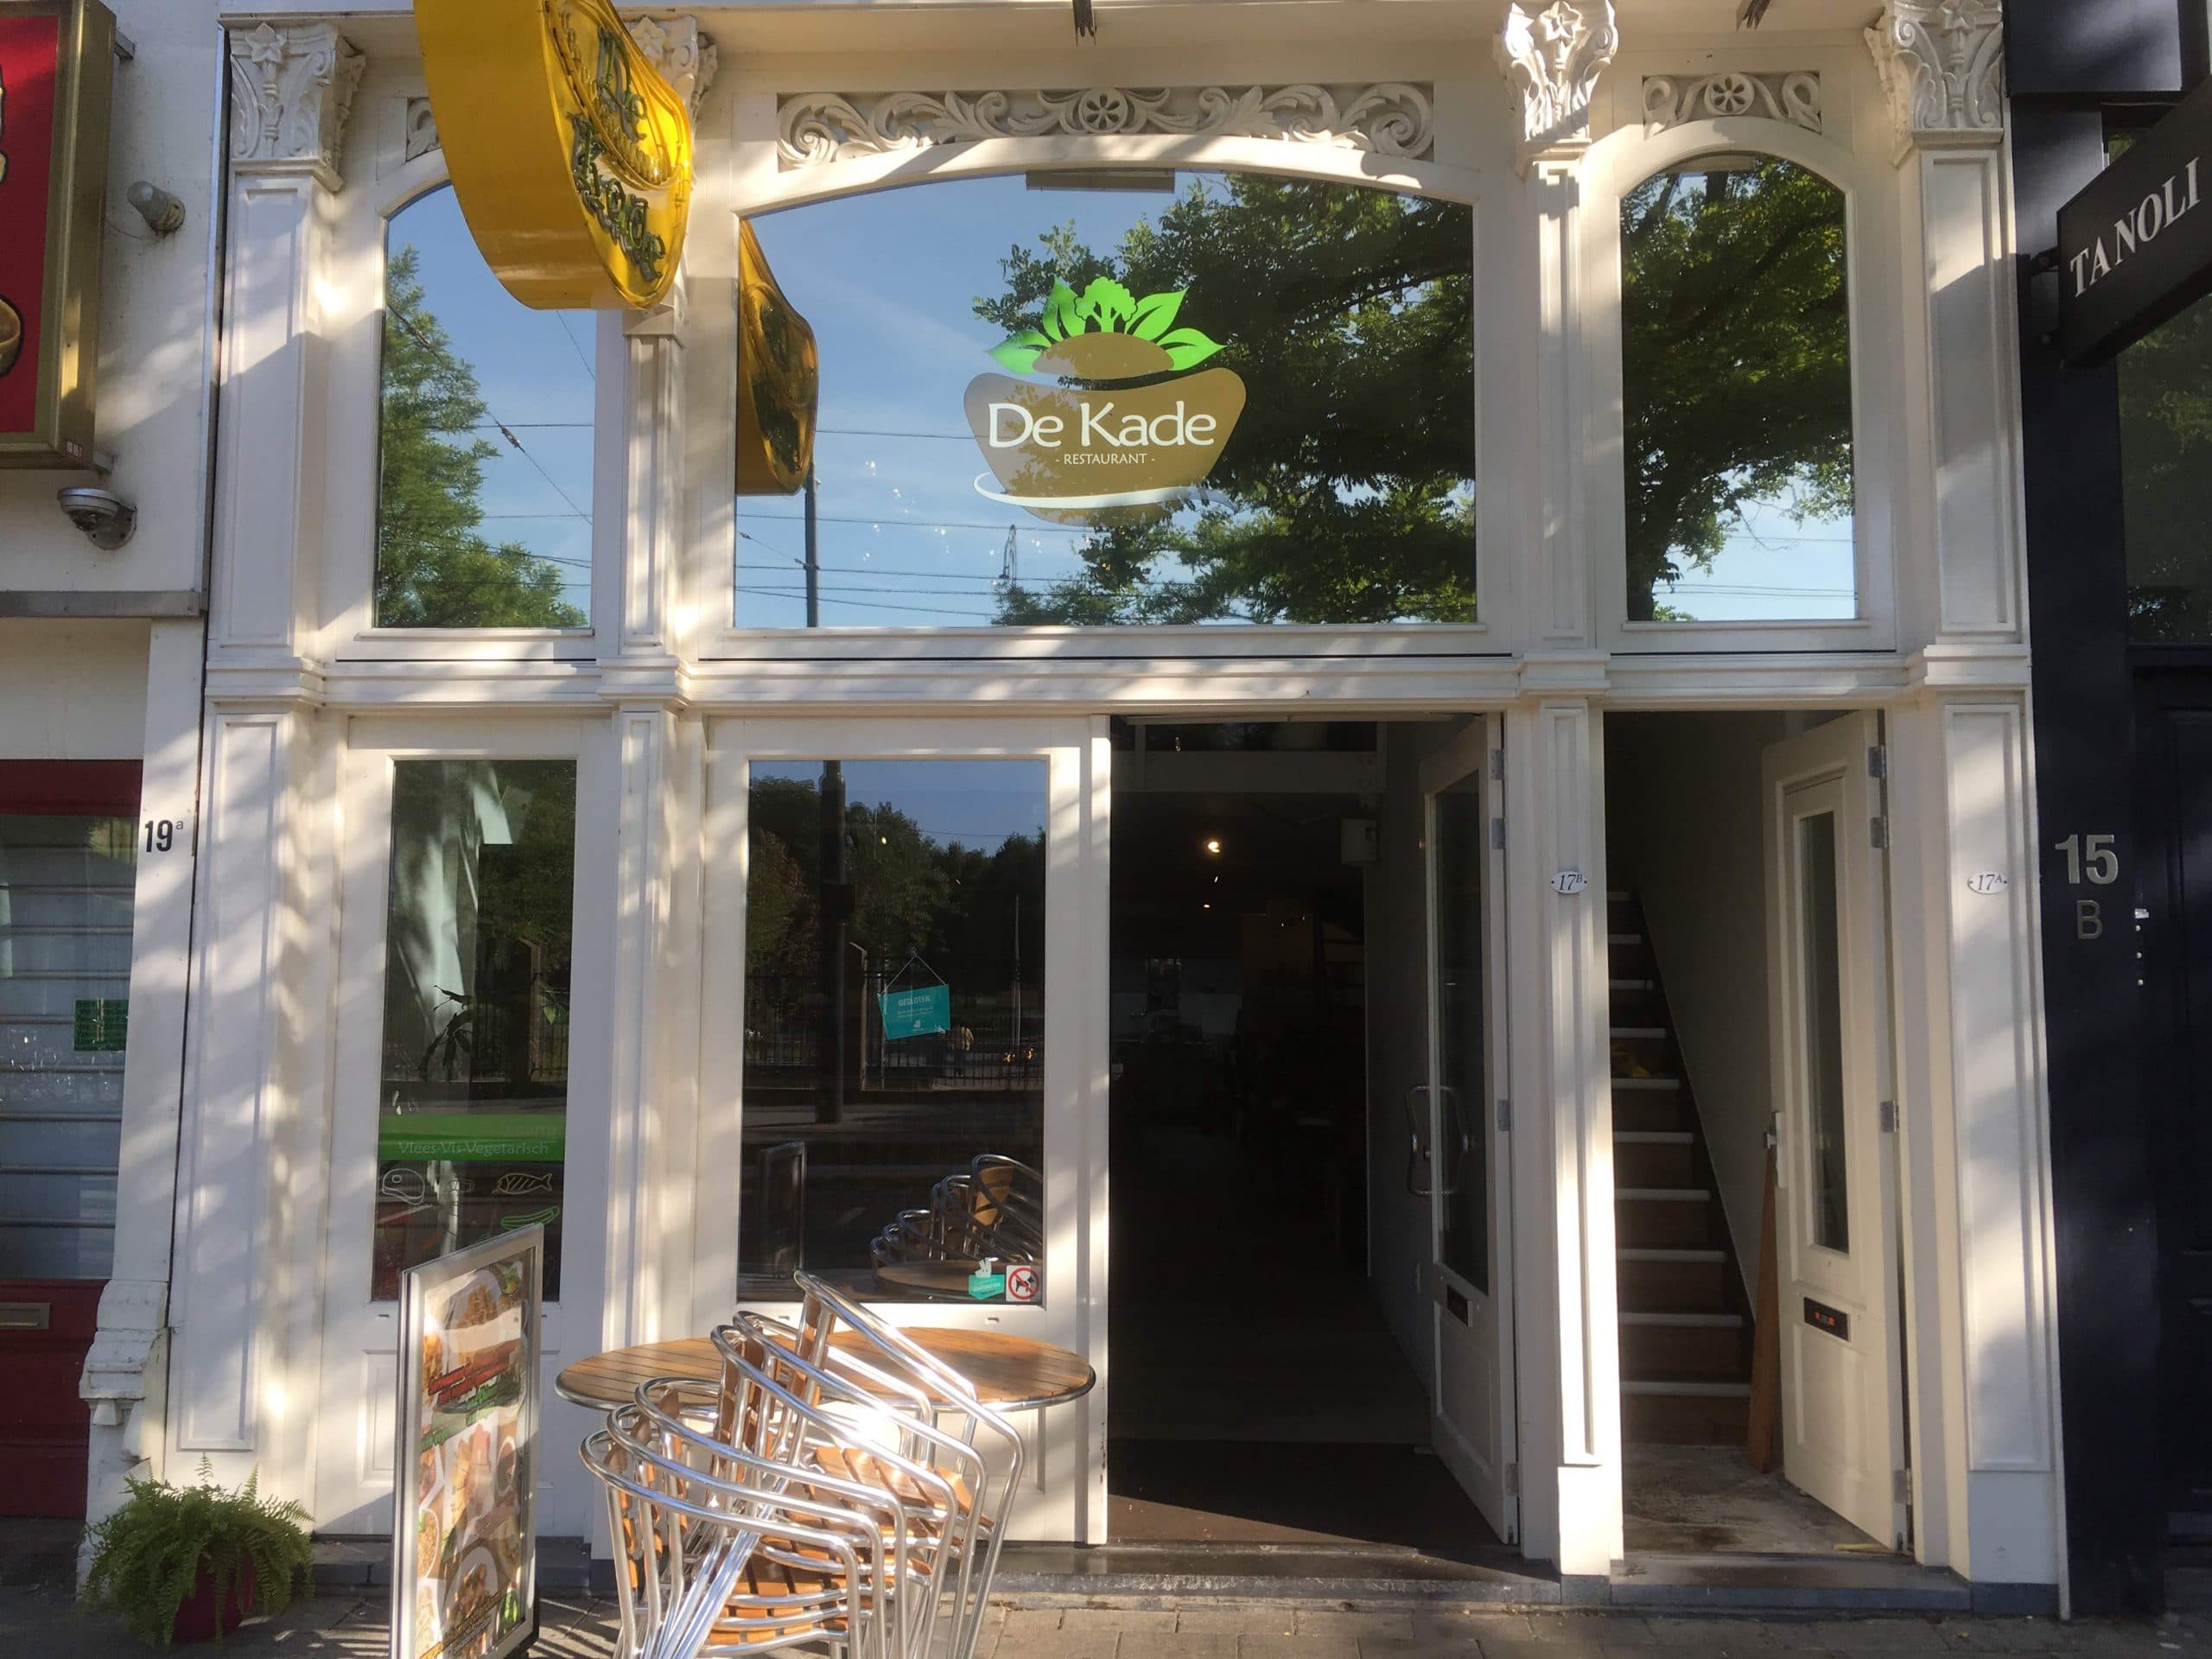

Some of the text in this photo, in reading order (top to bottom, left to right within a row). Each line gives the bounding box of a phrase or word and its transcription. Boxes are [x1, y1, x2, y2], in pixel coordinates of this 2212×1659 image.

[2070, 156, 2202, 297] TANOLI
[988, 400, 1217, 448] De Kade
[1064, 454, 1147, 465] RESTAURANT
[2055, 835, 2118, 885] 15
[1978, 874, 2003, 891] 17A
[2076, 899, 2102, 939] B
